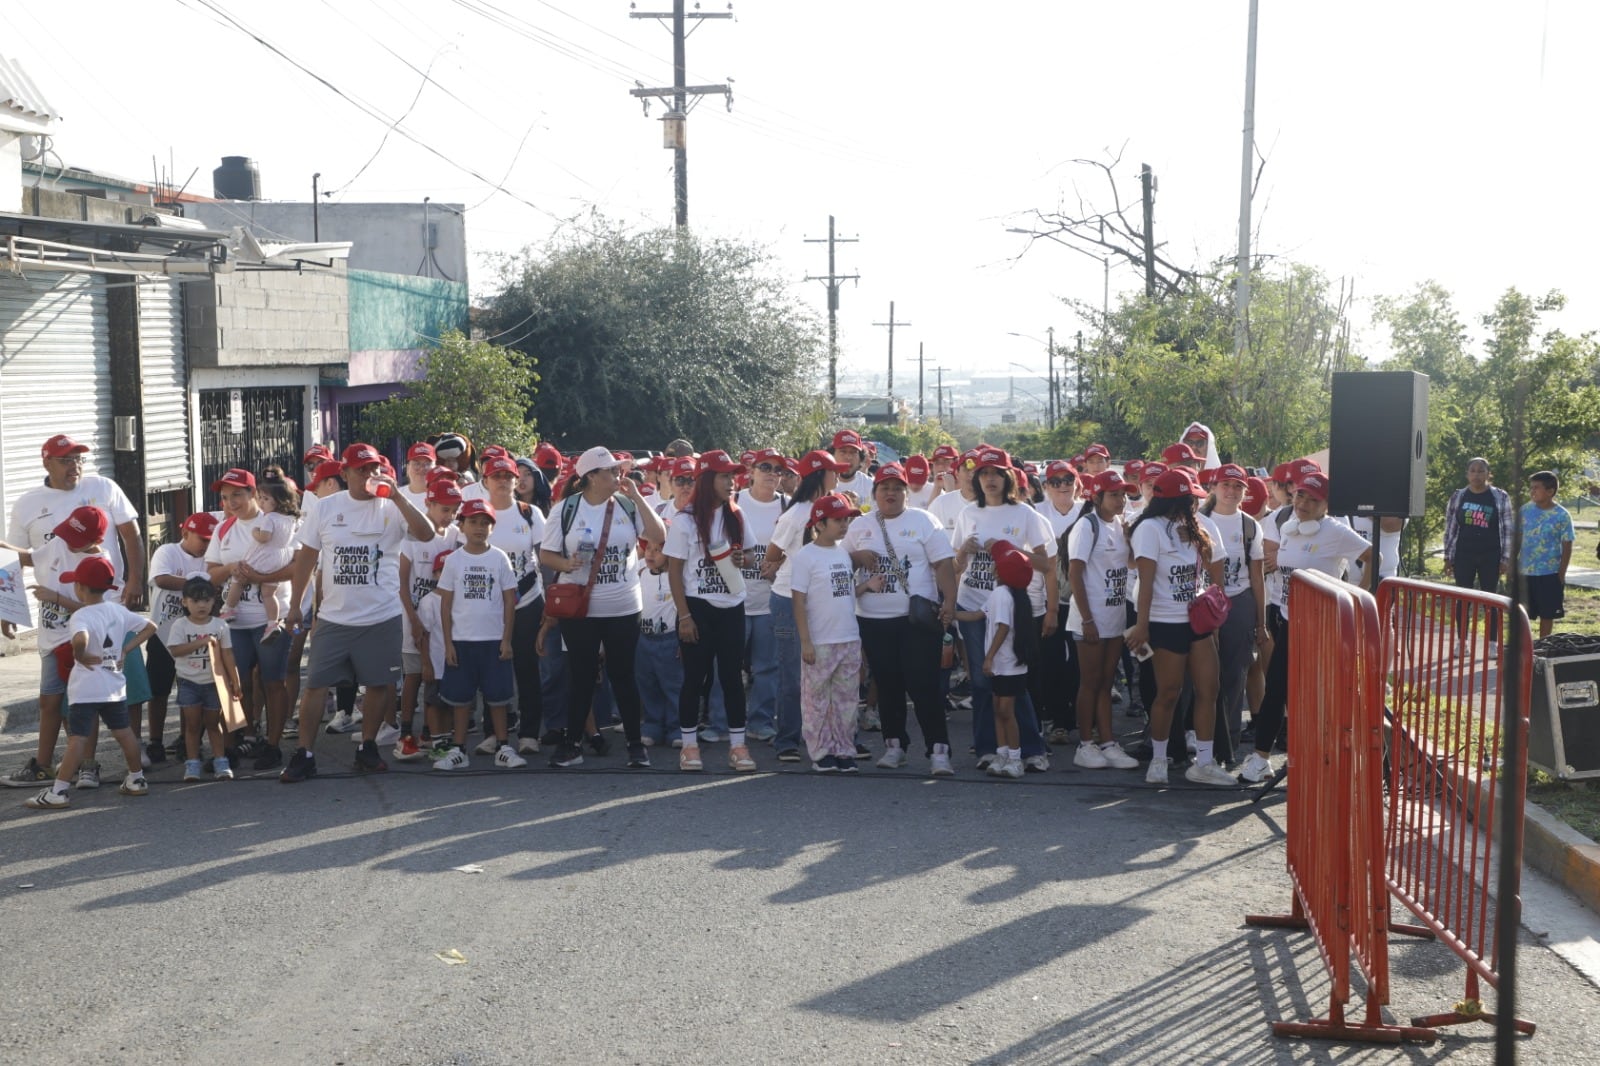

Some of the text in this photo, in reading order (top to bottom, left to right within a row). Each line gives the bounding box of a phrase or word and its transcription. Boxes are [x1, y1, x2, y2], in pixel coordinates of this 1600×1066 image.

[334, 545, 369, 555] CAMINA
[340, 554, 369, 564] TROTA
[340, 564, 369, 574] SALUD
[696, 569, 703, 577] Y
[333, 574, 369, 585] MENTAL
[597, 574, 619, 584] NTAL
[1104, 579, 1110, 587] Y
[1168, 576, 1174, 584] Y
[698, 586, 731, 594] MENTA
